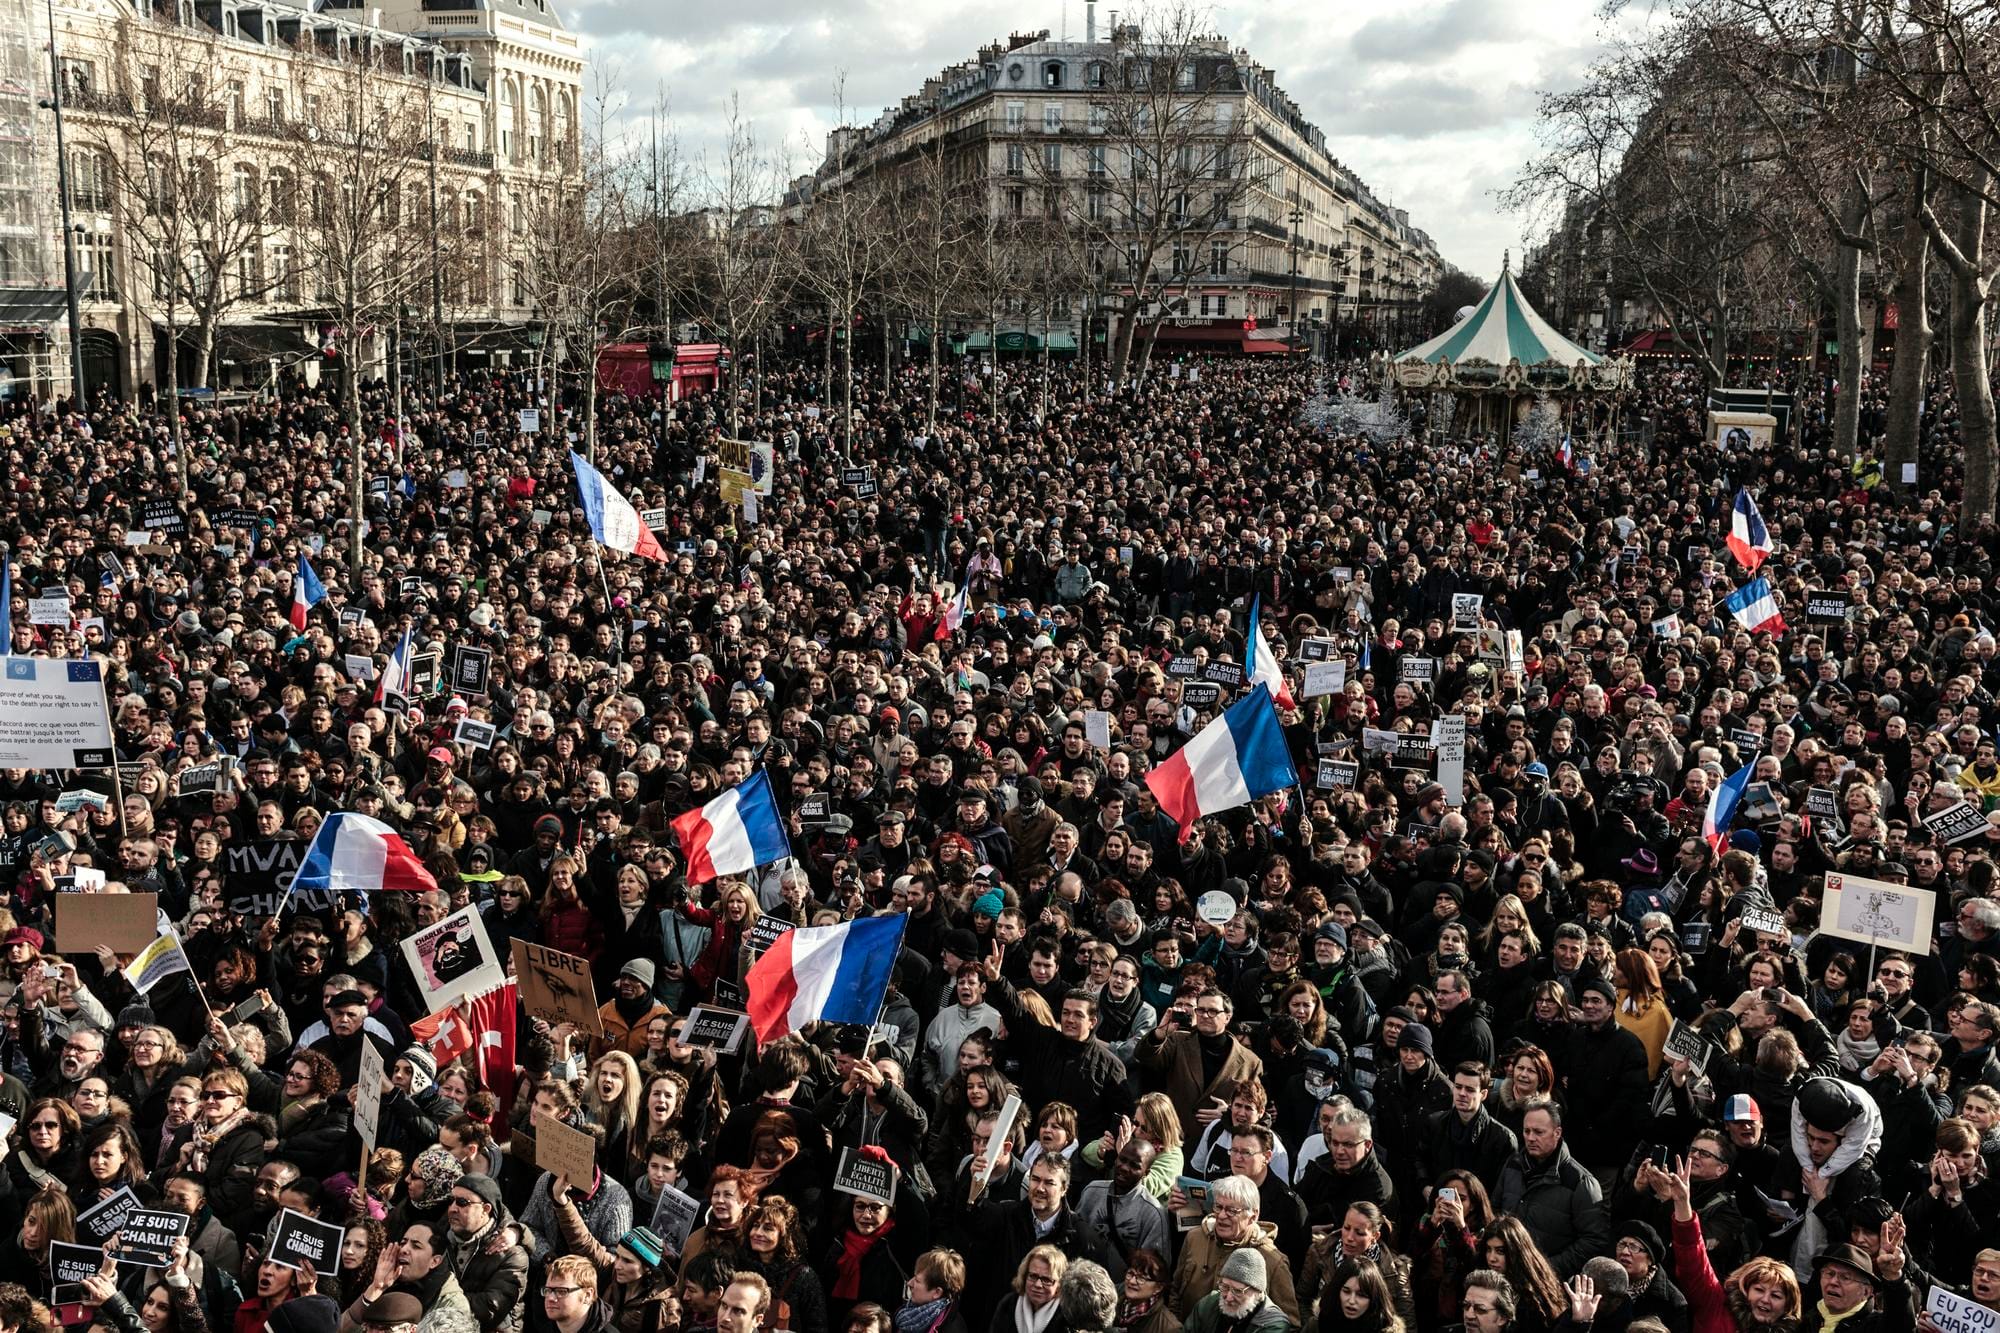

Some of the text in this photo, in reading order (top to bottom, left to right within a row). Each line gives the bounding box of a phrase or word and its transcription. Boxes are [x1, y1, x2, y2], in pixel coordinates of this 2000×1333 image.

[1808, 607, 1844, 616] CHARLIE
[1170, 664, 1195, 673] CHARLIE
[1220, 665, 1240, 675] SUIS
[1206, 670, 1240, 684] CHARLIE
[1396, 748, 1429, 760] HARLI
[182, 770, 216, 785] CHAR
[1321, 774, 1352, 784] CHARLIE
[1932, 806, 1973, 831] JE SUIS
[758, 918, 791, 932] JE SUIS
[1743, 916, 1783, 933] CHARLIE
[1762, 912, 1784, 925] SUIS
[415, 928, 443, 946] CHARLIE
[752, 928, 779, 940] CHAR
[526, 945, 584, 975] LIBRE
[719, 990, 736, 1001] JE
[692, 1026, 732, 1039] CHARLIE
[710, 1021, 734, 1030] SUIS
[89, 1198, 133, 1229] JE SUIS
[94, 1211, 128, 1236] CHAR
[146, 1216, 178, 1230] SUIS
[120, 1230, 176, 1247] CHARLIE
[290, 1230, 324, 1248] JE SUIS
[287, 1239, 323, 1260] CHARLIE
[59, 1260, 96, 1272] JE SUIS
[1937, 1294, 1995, 1328] EU SOU
